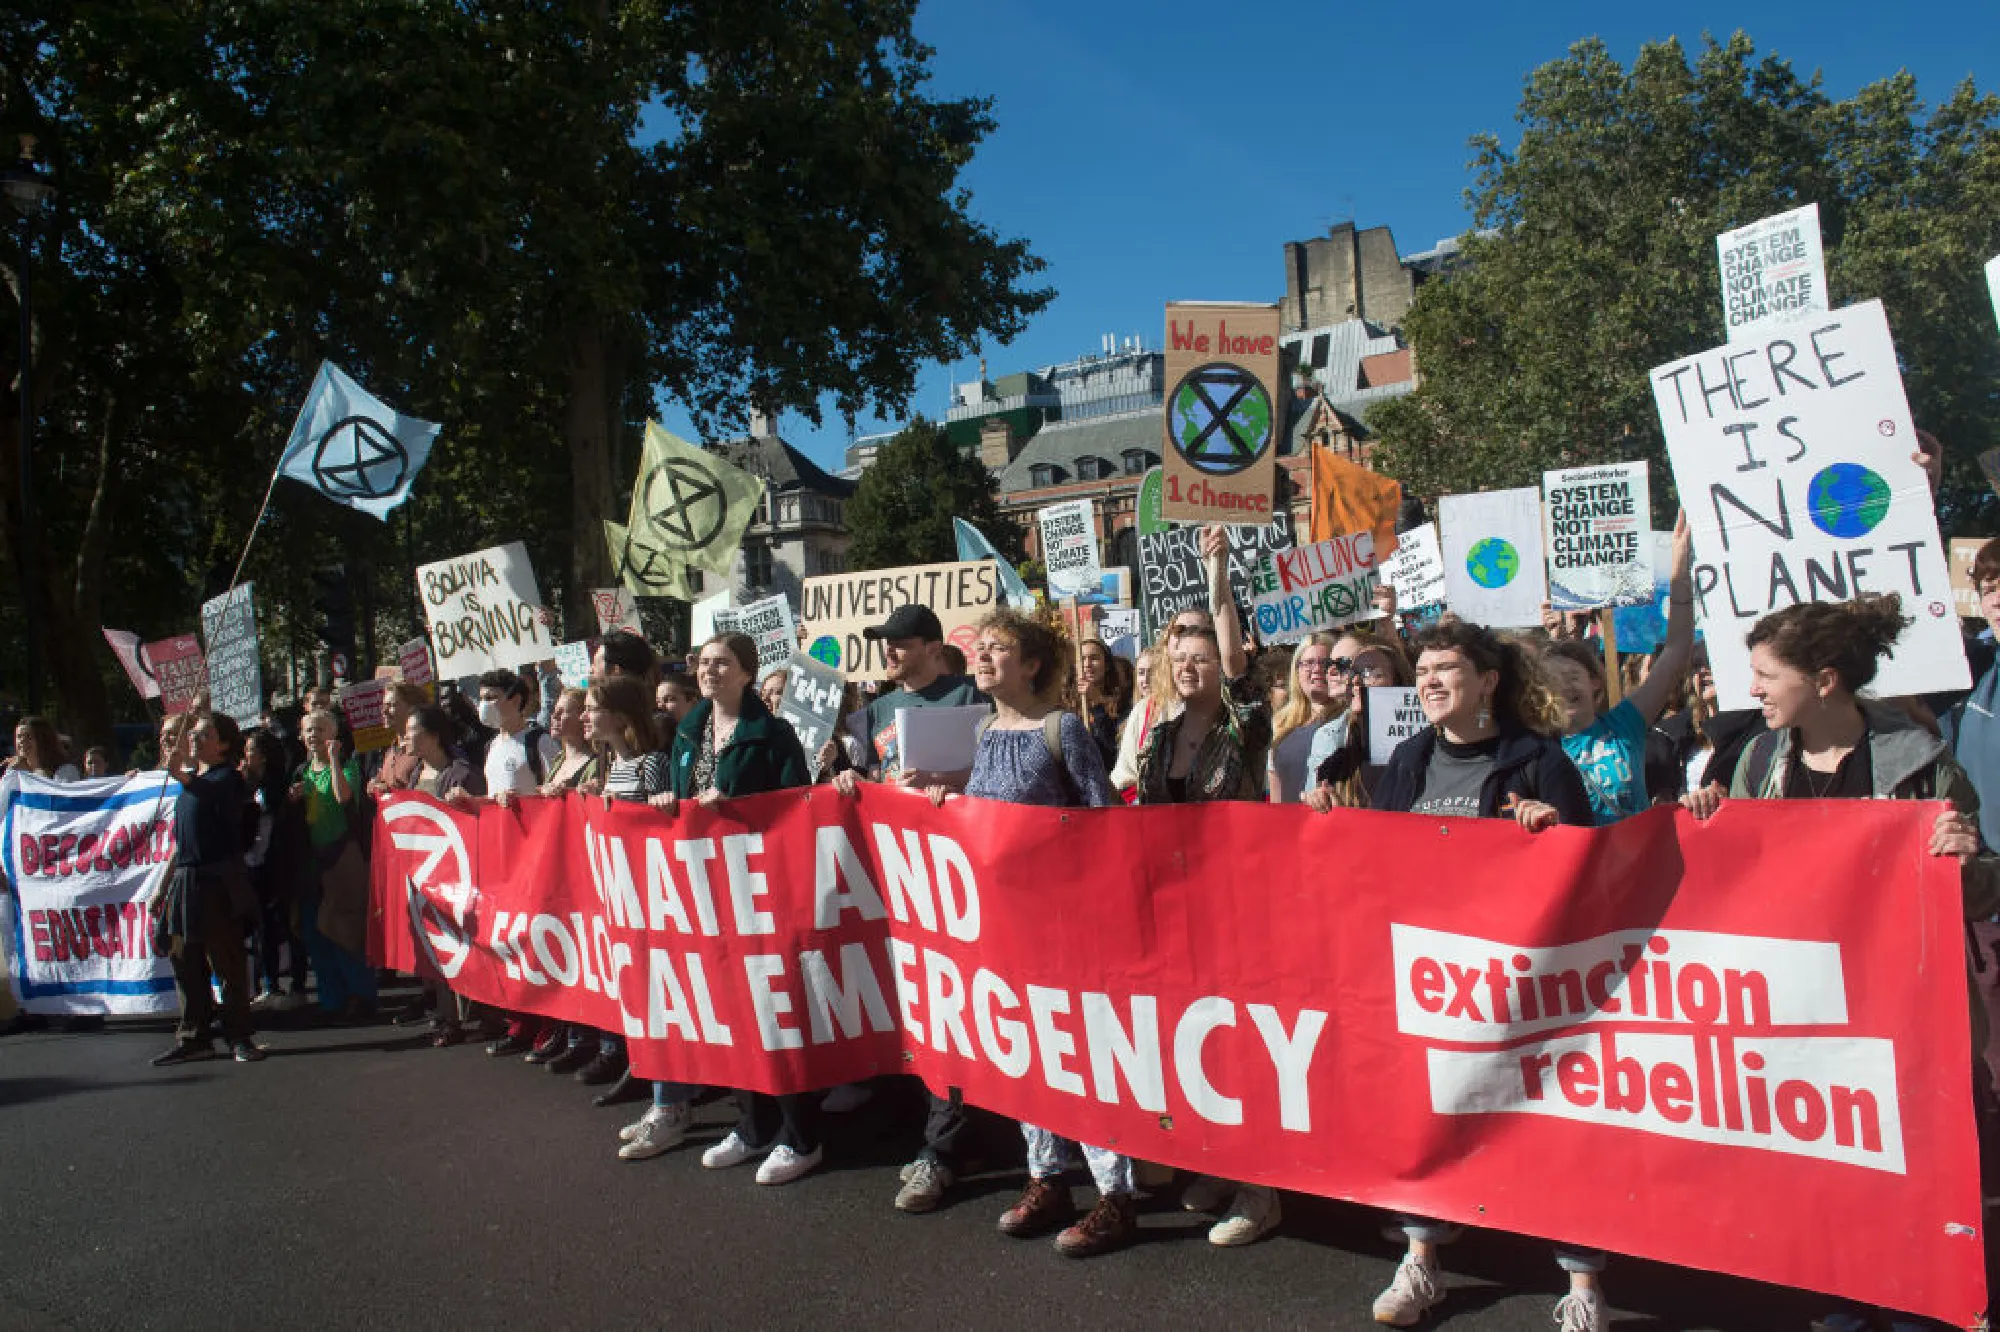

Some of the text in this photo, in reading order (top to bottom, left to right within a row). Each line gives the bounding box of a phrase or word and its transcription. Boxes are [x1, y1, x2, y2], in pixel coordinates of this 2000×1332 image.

[1723, 228, 1800, 265] SYSTEM
[1726, 241, 1807, 280] CHANGE
[1727, 270, 1762, 296] NOT
[1729, 273, 1812, 312] CLIMATE
[1730, 290, 1811, 326] CHANGE
[1170, 319, 1275, 356] We have
[1658, 323, 1866, 424] THERE
[1722, 416, 1807, 472] IS
[1166, 474, 1183, 502] 1
[1186, 478, 1269, 513] chance
[1550, 482, 1631, 504] SYSTEM
[1551, 498, 1635, 520] CHANGE
[1552, 519, 1592, 537] NOT
[1553, 531, 1639, 553] CLIMATE
[1276, 532, 1376, 593] KILLING
[1554, 549, 1638, 568] CHANGE
[425, 558, 499, 605] BOLIVIA
[804, 566, 993, 621] UNIVERSITIES
[1694, 541, 1927, 618] PLANET
[461, 591, 481, 612] IS
[435, 600, 539, 658] BURNING
[1394, 709, 1427, 723] WIT
[813, 823, 981, 942] AND
[1409, 935, 1772, 1028] extinction
[744, 936, 1329, 1133] EMERGENCY
[1521, 1031, 1883, 1153] rebellion
